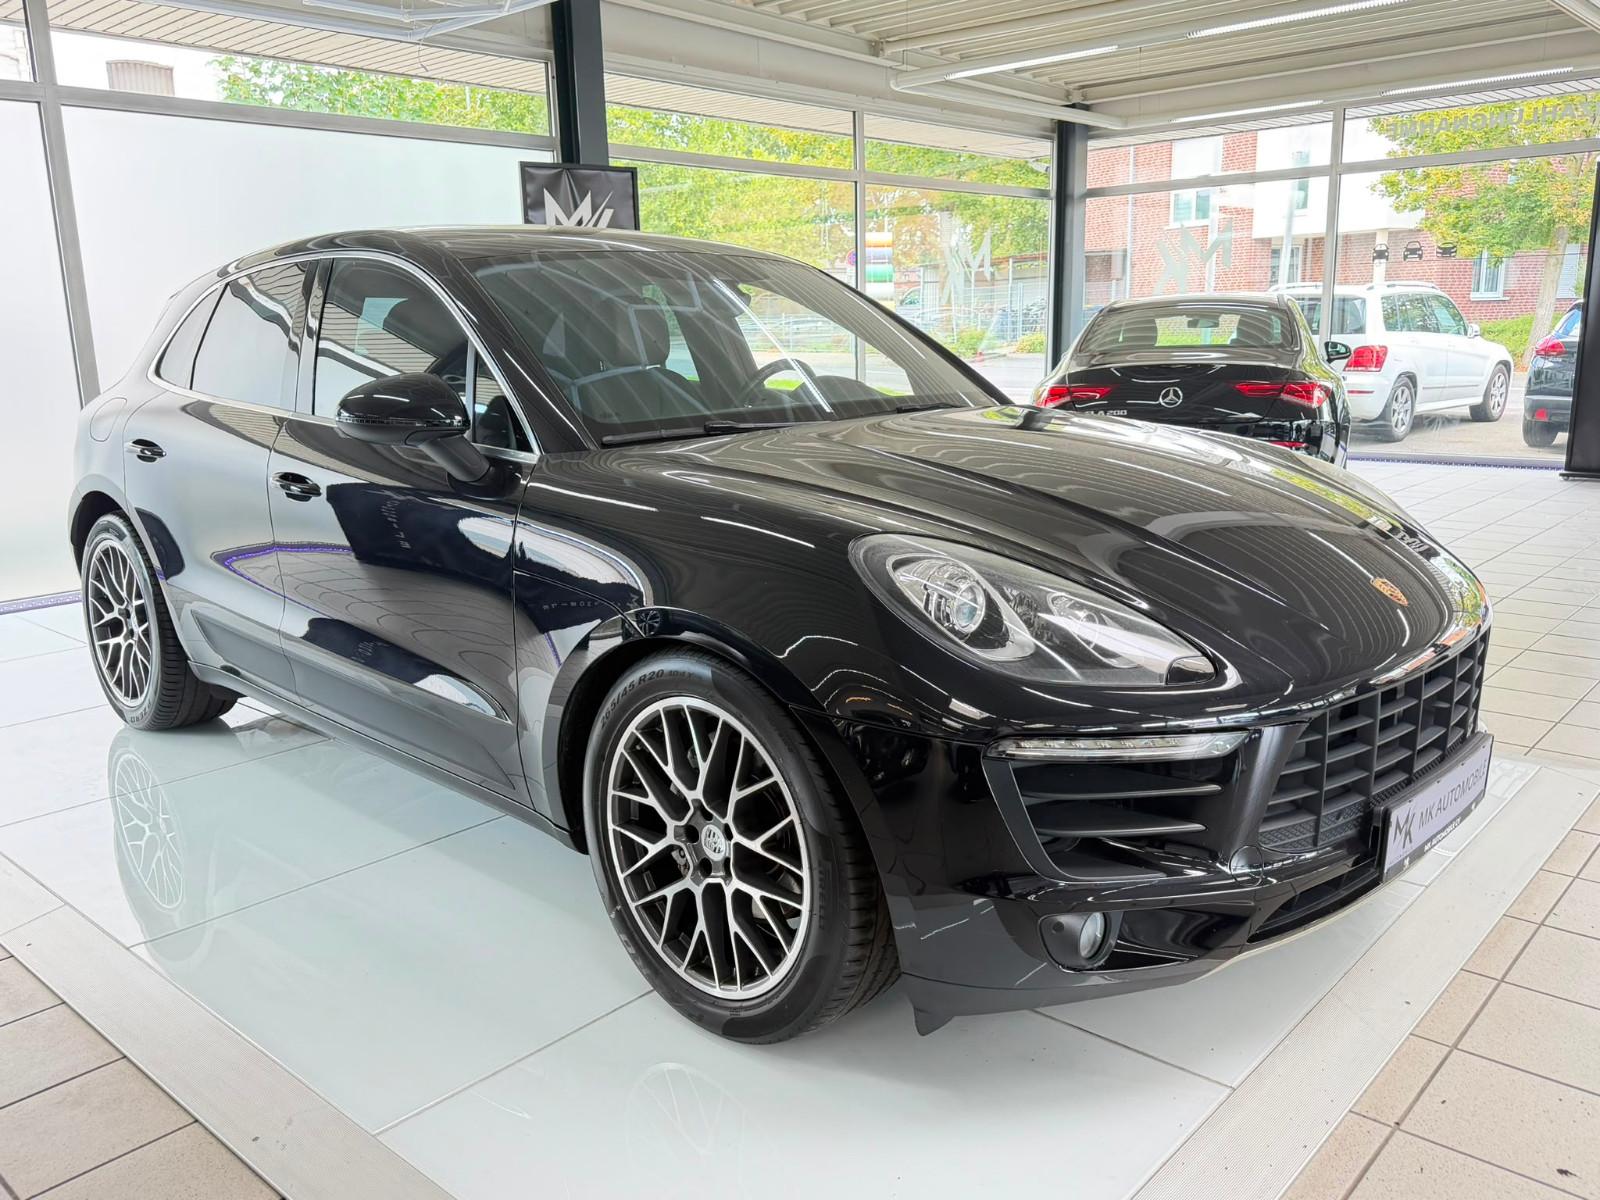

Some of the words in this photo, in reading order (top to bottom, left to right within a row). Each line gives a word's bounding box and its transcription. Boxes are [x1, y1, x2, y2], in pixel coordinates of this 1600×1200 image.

[600, 680, 635, 729] 265/45
[638, 668, 665, 686] R20
[1419, 804, 1434, 830] MK
